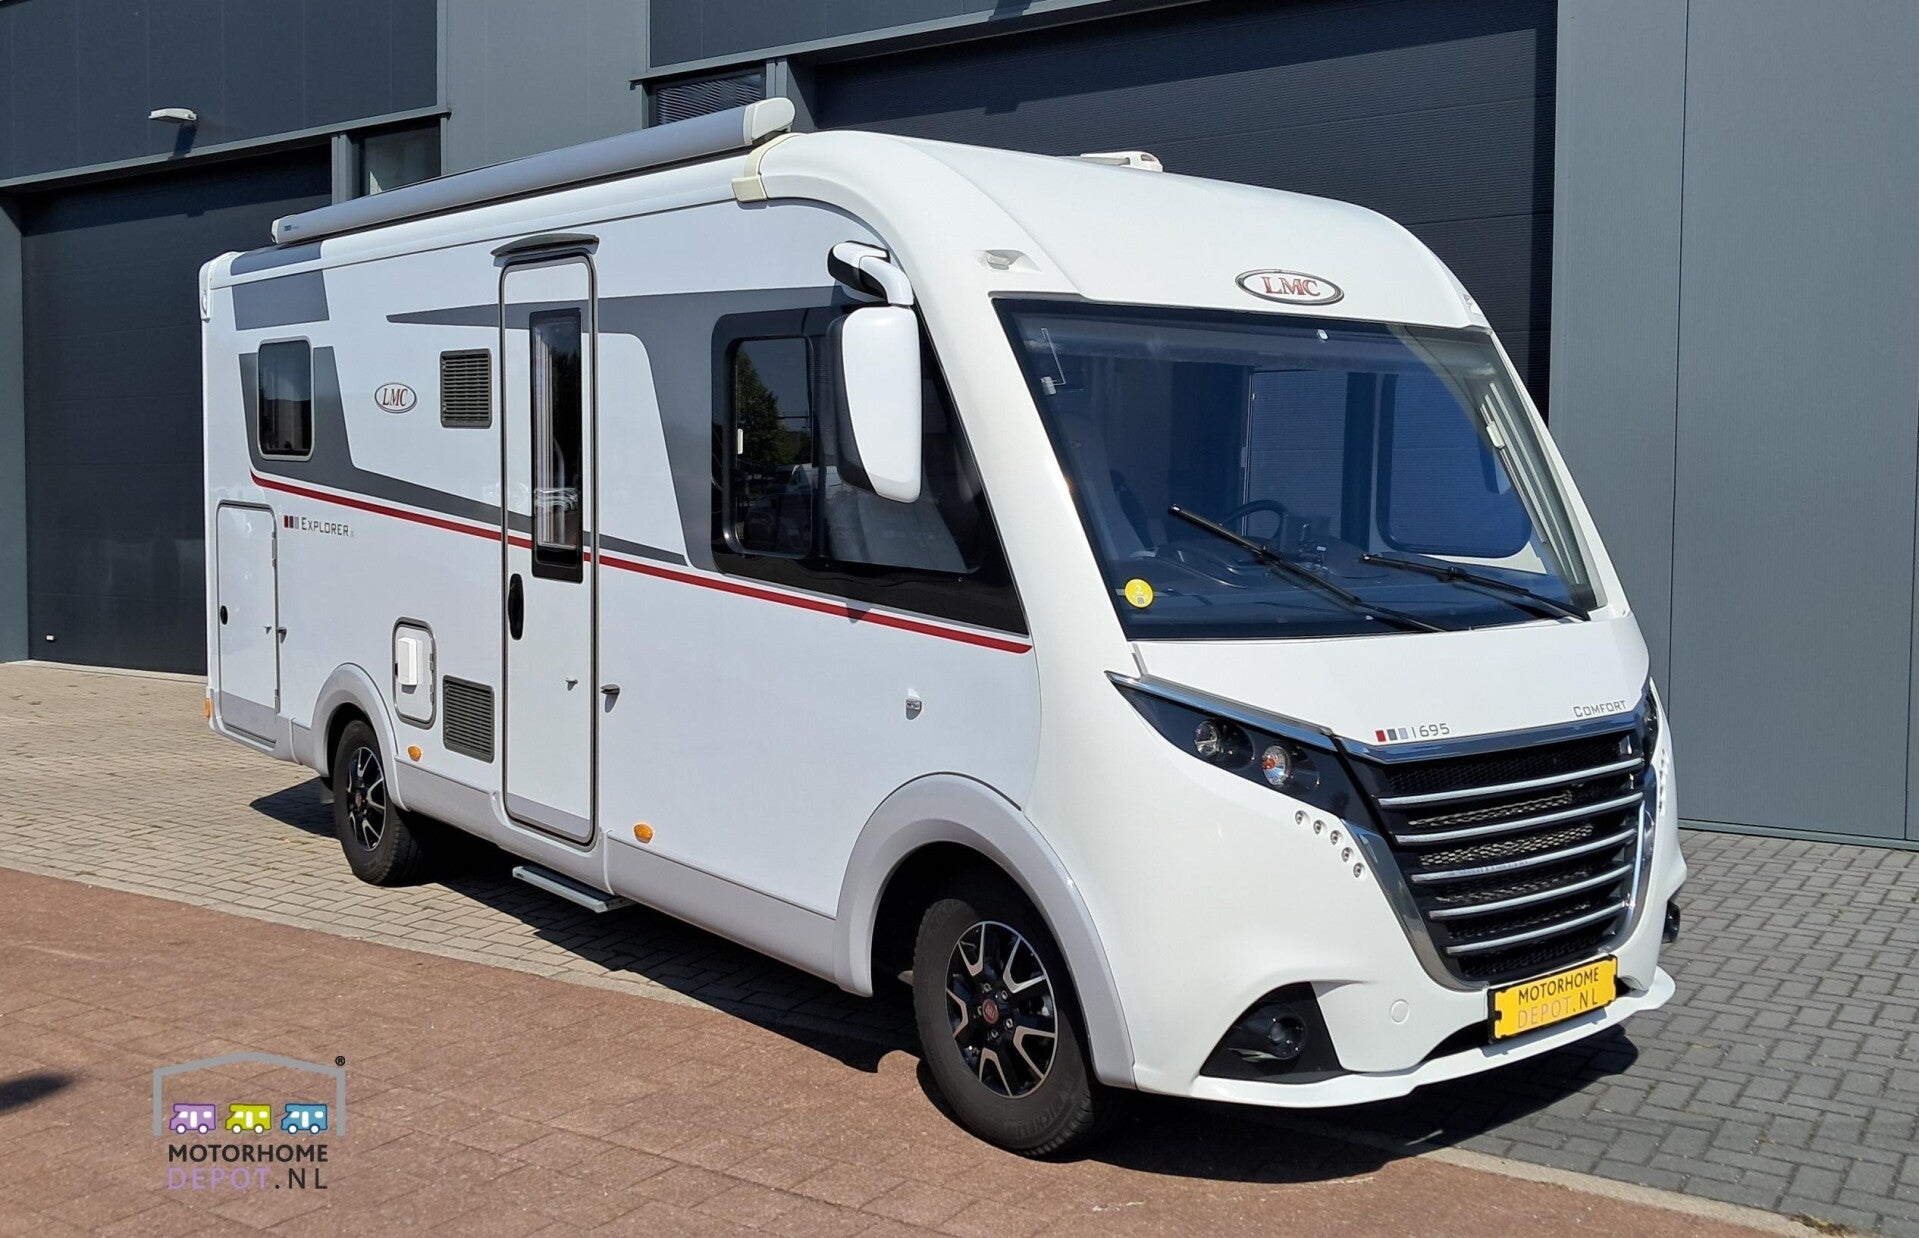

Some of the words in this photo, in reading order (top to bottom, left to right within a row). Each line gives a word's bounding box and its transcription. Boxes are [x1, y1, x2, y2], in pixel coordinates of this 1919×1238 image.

[1261, 276, 1321, 297] LMC
[382, 388, 408, 407] LMC
[1420, 722, 1450, 738] 695
[1518, 966, 1600, 1006] MOTORHOME
[1518, 988, 1599, 1029] DEPOT.NL
